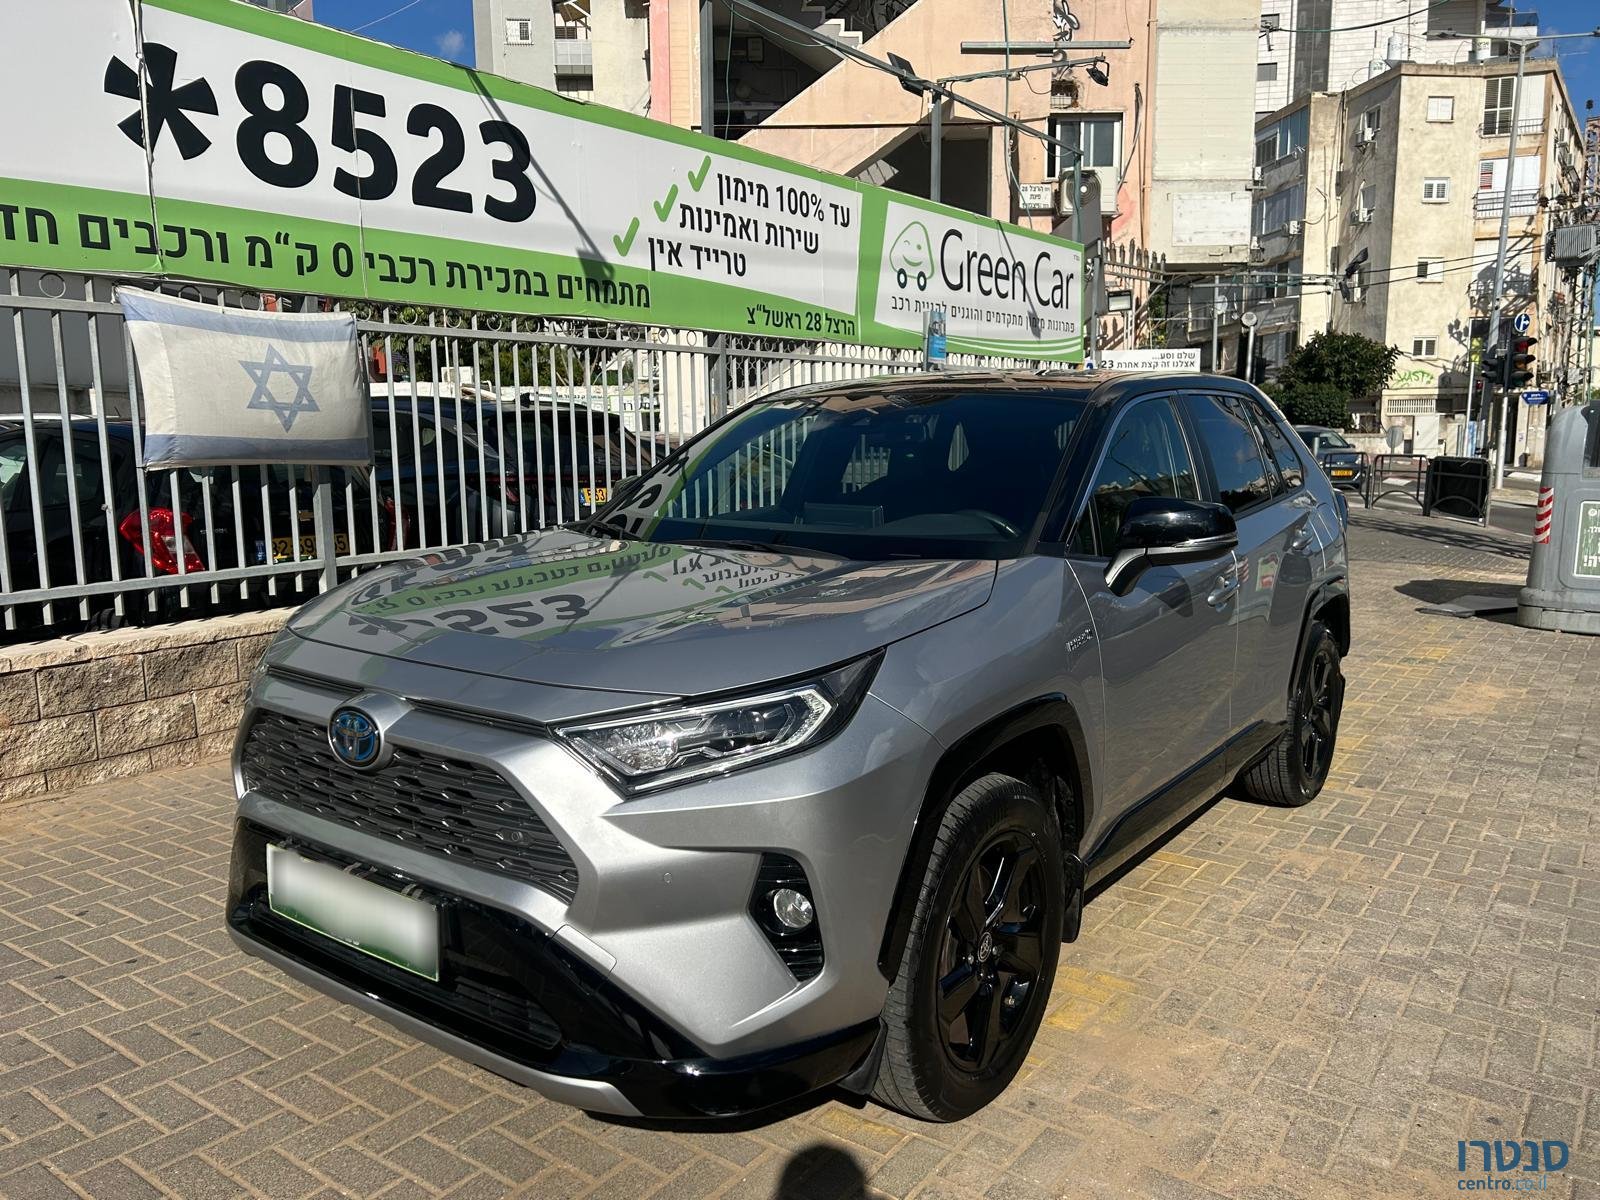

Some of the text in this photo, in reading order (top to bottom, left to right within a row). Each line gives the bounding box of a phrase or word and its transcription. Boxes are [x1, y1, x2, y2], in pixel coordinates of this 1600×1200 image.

[717, 172, 851, 228] עד 100% מימון
[77, 213, 230, 264] ורכבים
[679, 202, 819, 254] שירות ואמינות
[332, 241, 354, 278] 0
[364, 252, 437, 286] רכבי
[647, 236, 747, 277] טרייד אין
[940, 228, 1074, 310] Green Car
[445, 260, 550, 297] במכירת
[556, 273, 651, 308] מתמחים
[891, 295, 911, 312] רכב
[951, 305, 983, 322] והוגנים
[986, 310, 1023, 329] מתקדמים
[805, 311, 822, 332] 28
[824, 312, 856, 336] הרצל
[1047, 319, 1075, 333] פתרונות
